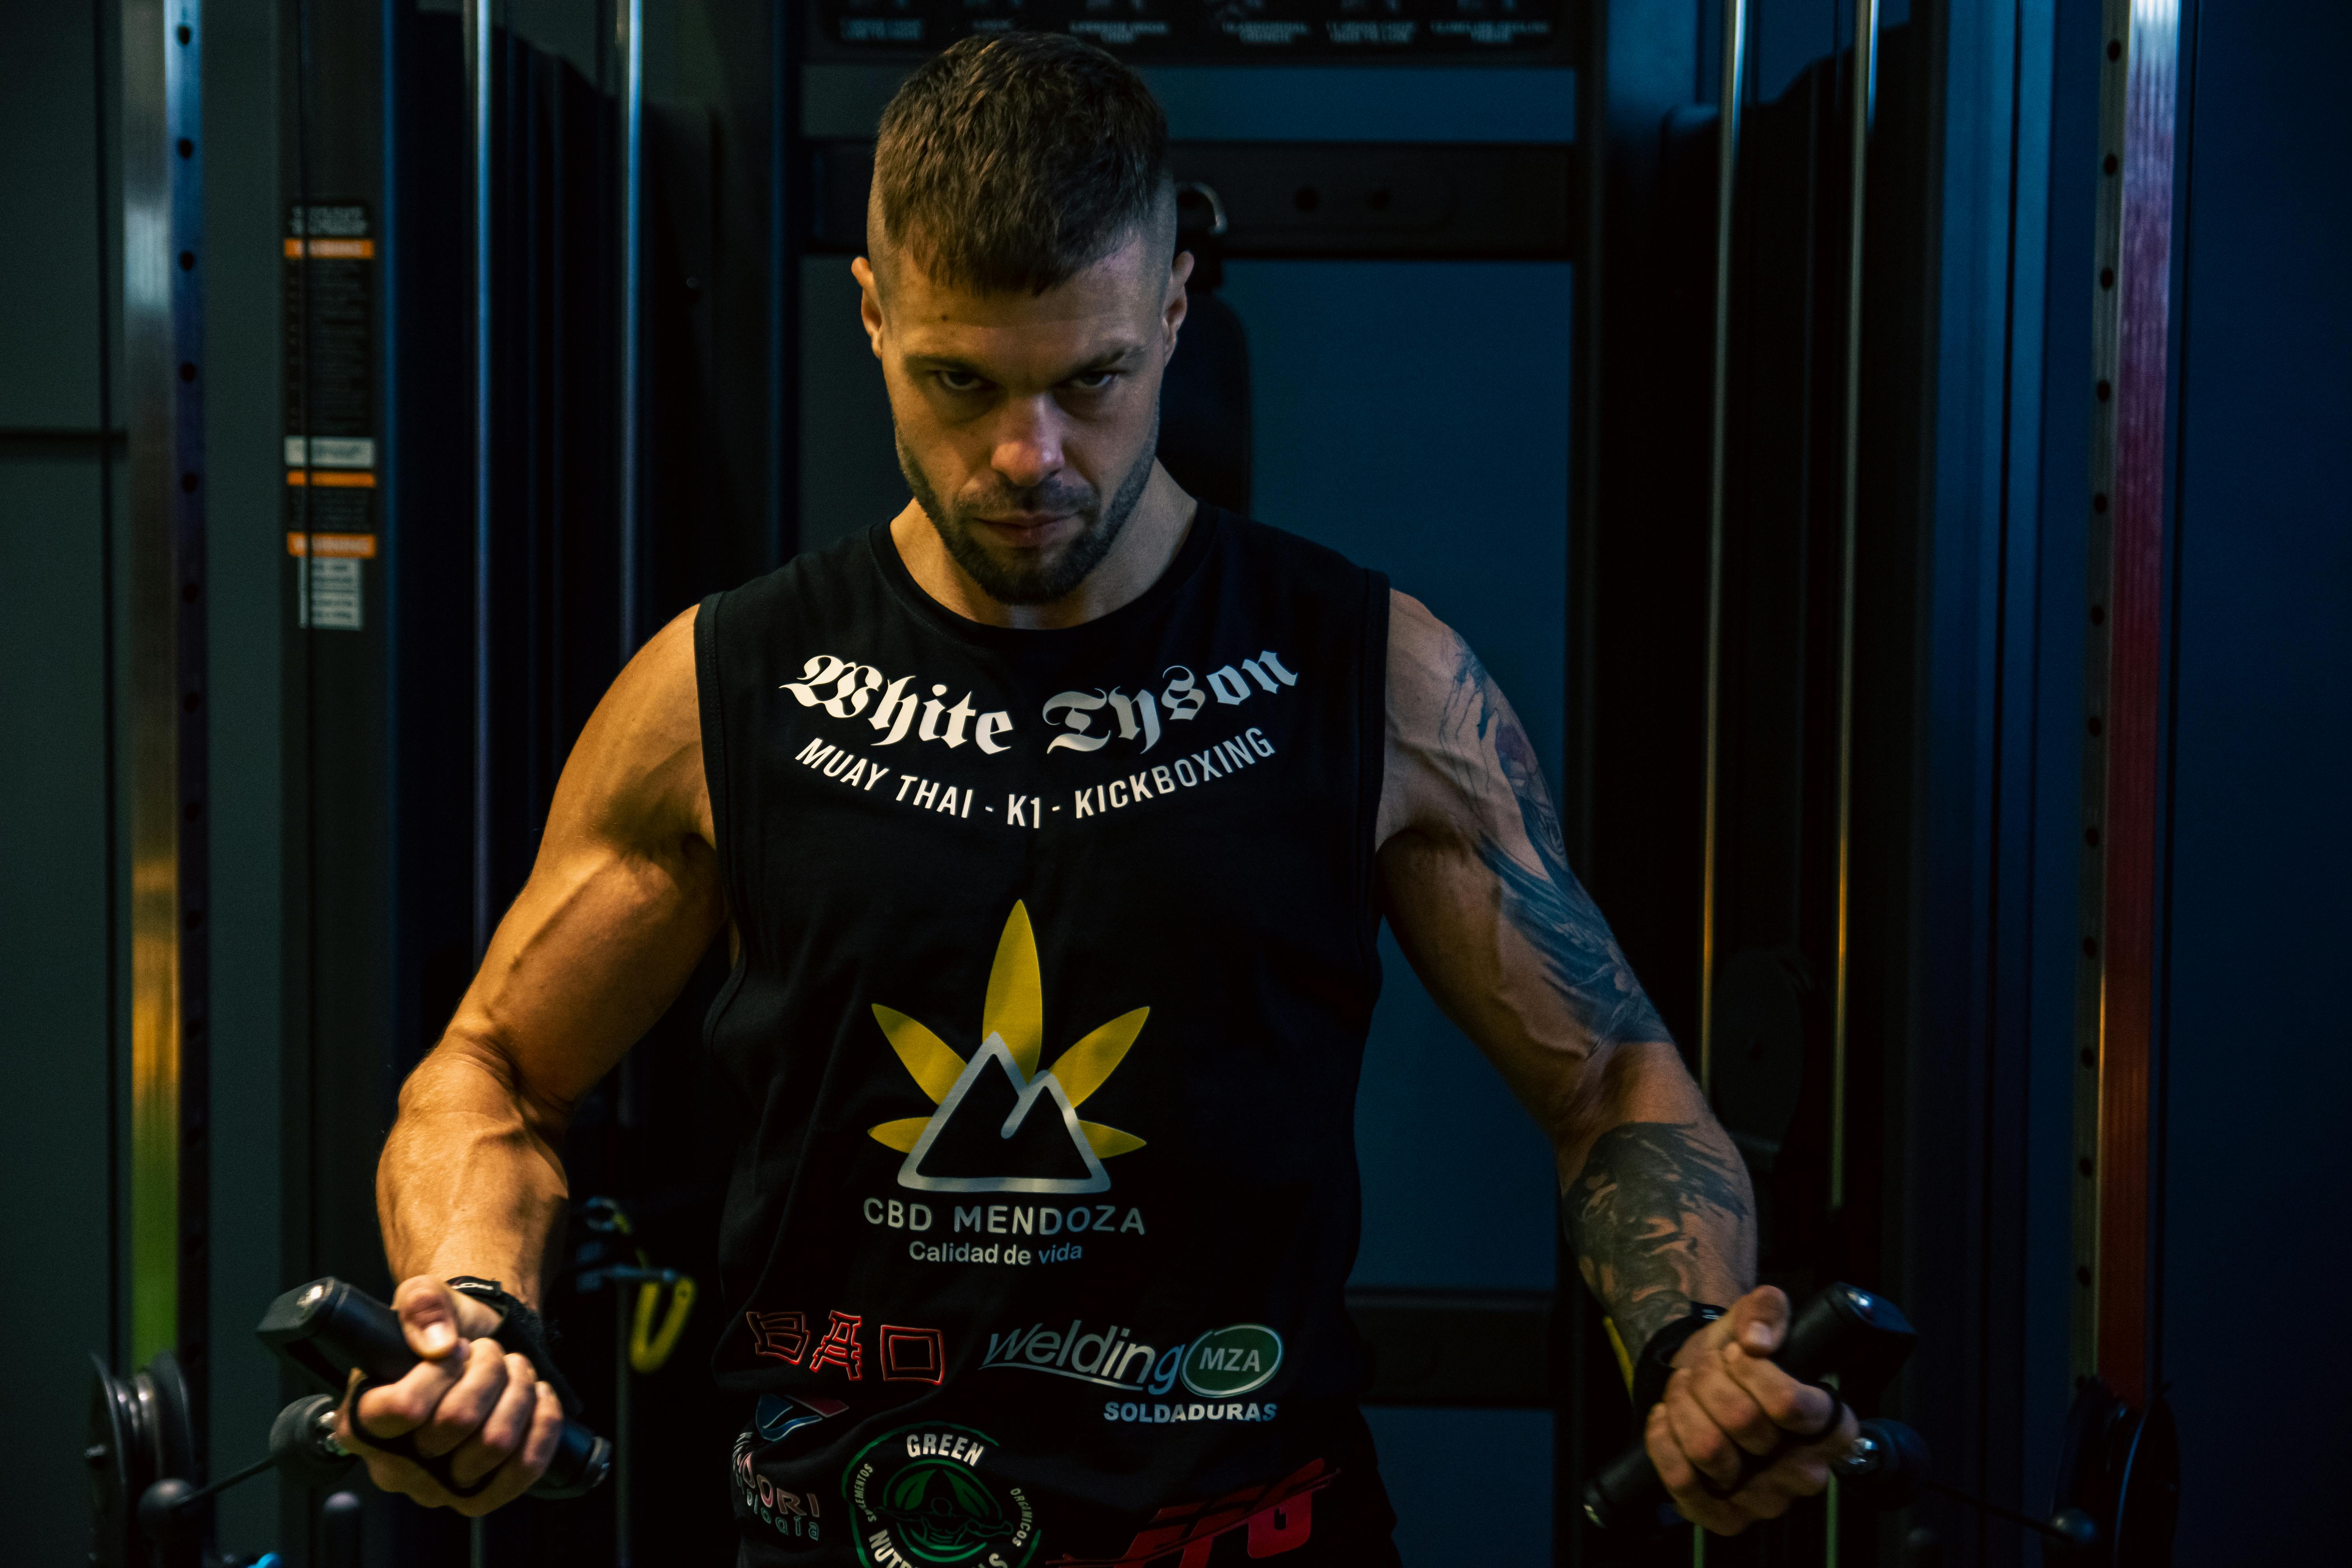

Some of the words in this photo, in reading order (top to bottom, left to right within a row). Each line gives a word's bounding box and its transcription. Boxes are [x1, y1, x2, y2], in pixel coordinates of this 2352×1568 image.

[778, 654, 1014, 755] White
[1042, 650, 1299, 755] Tyson
[794, 737, 889, 791] MUAY
[895, 774, 974, 819] THAI
[1007, 793, 1041, 829] K1
[1074, 726, 1276, 820] KICKBOXING
[863, 1197, 933, 1231] CBD
[953, 1204, 1146, 1236] MENDOZA
[909, 1241, 999, 1264] Calidad
[1004, 1244, 1031, 1266] de
[1038, 1242, 1083, 1265] vida
[1198, 1347, 1260, 1373] MZA
[1103, 1401, 1278, 1424] SOLDADURAS
[906, 1433, 985, 1467] GREEN
[854, 1463, 877, 1523] SLEMENTOS
